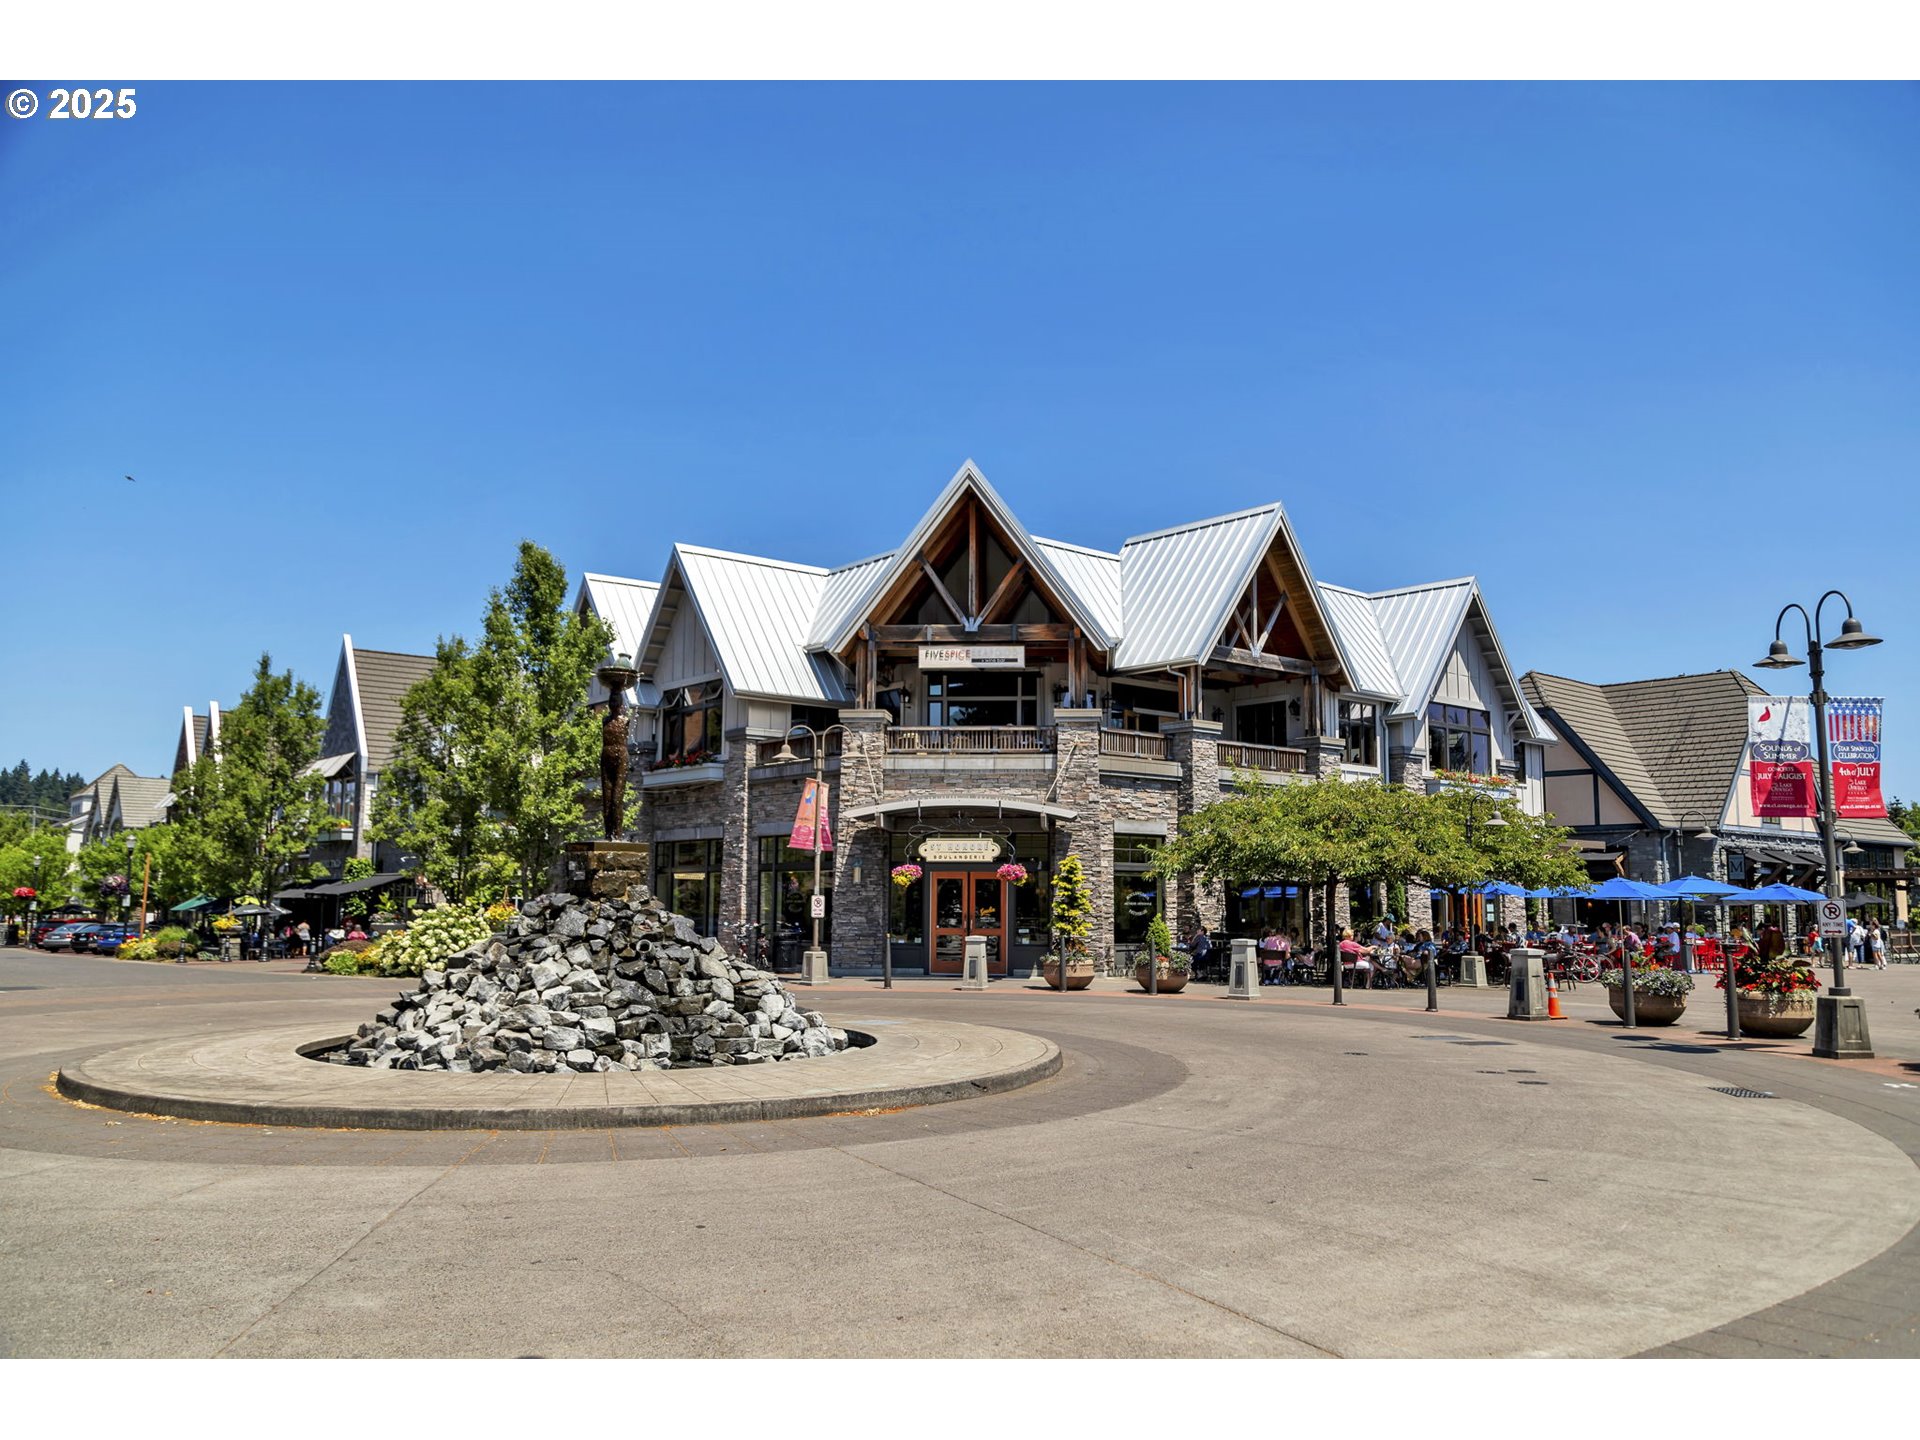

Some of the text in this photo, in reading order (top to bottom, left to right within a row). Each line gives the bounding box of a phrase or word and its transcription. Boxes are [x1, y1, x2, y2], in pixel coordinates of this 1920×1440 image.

[1760, 743, 1793, 752] SOUNDS
[1850, 745, 1876, 753] SPANGLED
[1763, 751, 1798, 760] SUMMER
[1757, 772, 1773, 780] JULY
[1777, 772, 1807, 780] AUGUST
[1838, 766, 1850, 776] 4th
[1856, 766, 1876, 778] JULY
[1730, 860, 1743, 873] M
